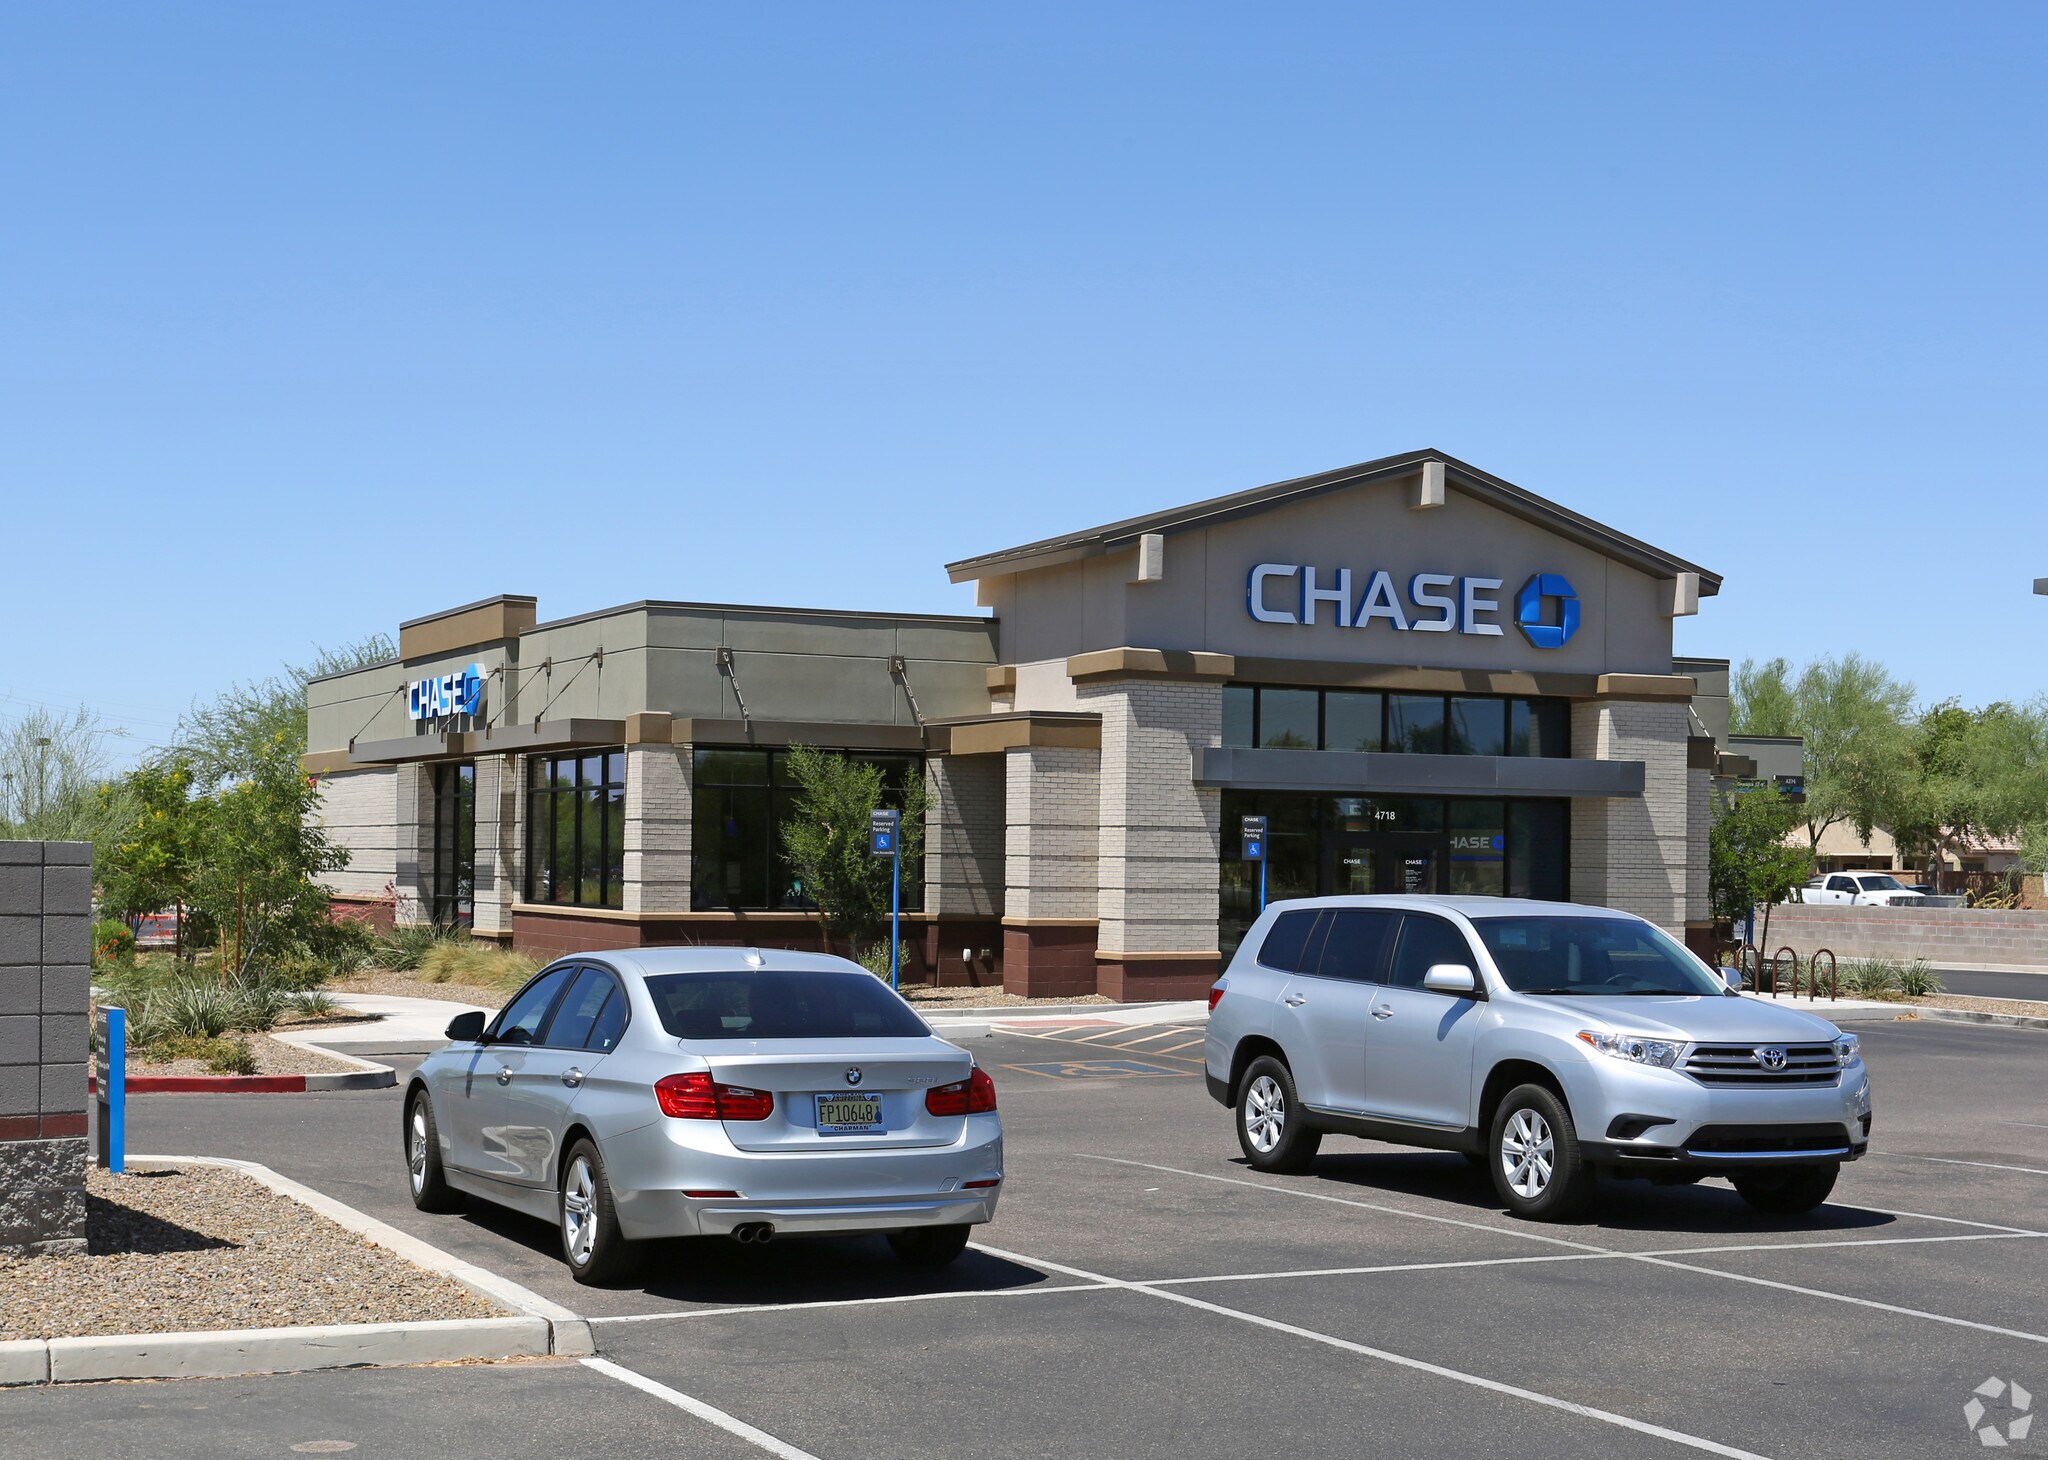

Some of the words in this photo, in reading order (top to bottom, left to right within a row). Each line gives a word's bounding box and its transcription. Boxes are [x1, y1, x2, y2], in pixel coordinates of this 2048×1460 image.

[1246, 563, 1504, 636] CHASE
[409, 672, 466, 720] CHASE
[1374, 811, 1396, 820] 4718
[1450, 837, 1490, 849] HASE
[820, 1104, 873, 1122] FP10648
